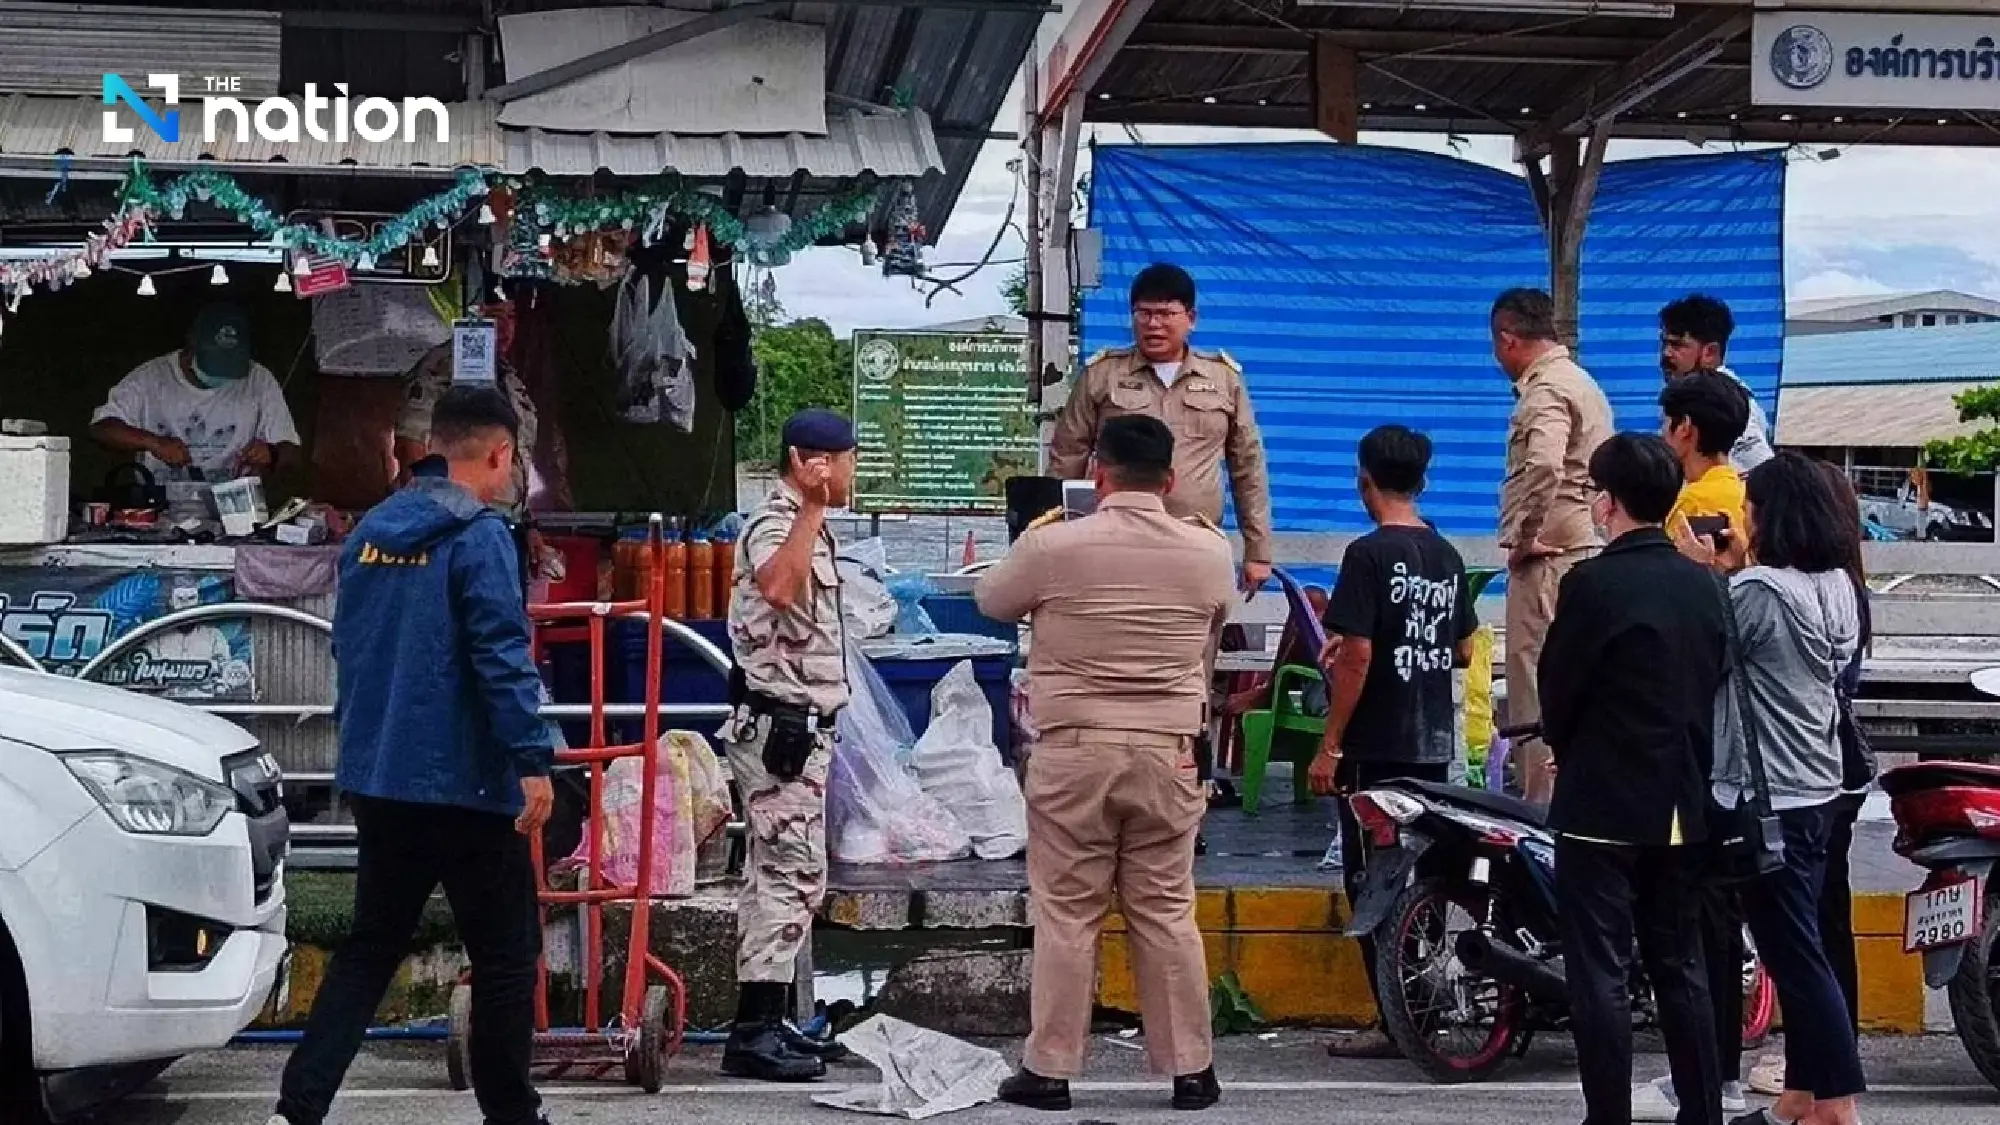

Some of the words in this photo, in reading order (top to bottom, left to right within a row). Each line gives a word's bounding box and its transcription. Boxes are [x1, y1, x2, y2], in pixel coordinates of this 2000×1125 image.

[1845, 33, 2000, 79] องค์การบริ
[1915, 920, 1964, 946] 2980
